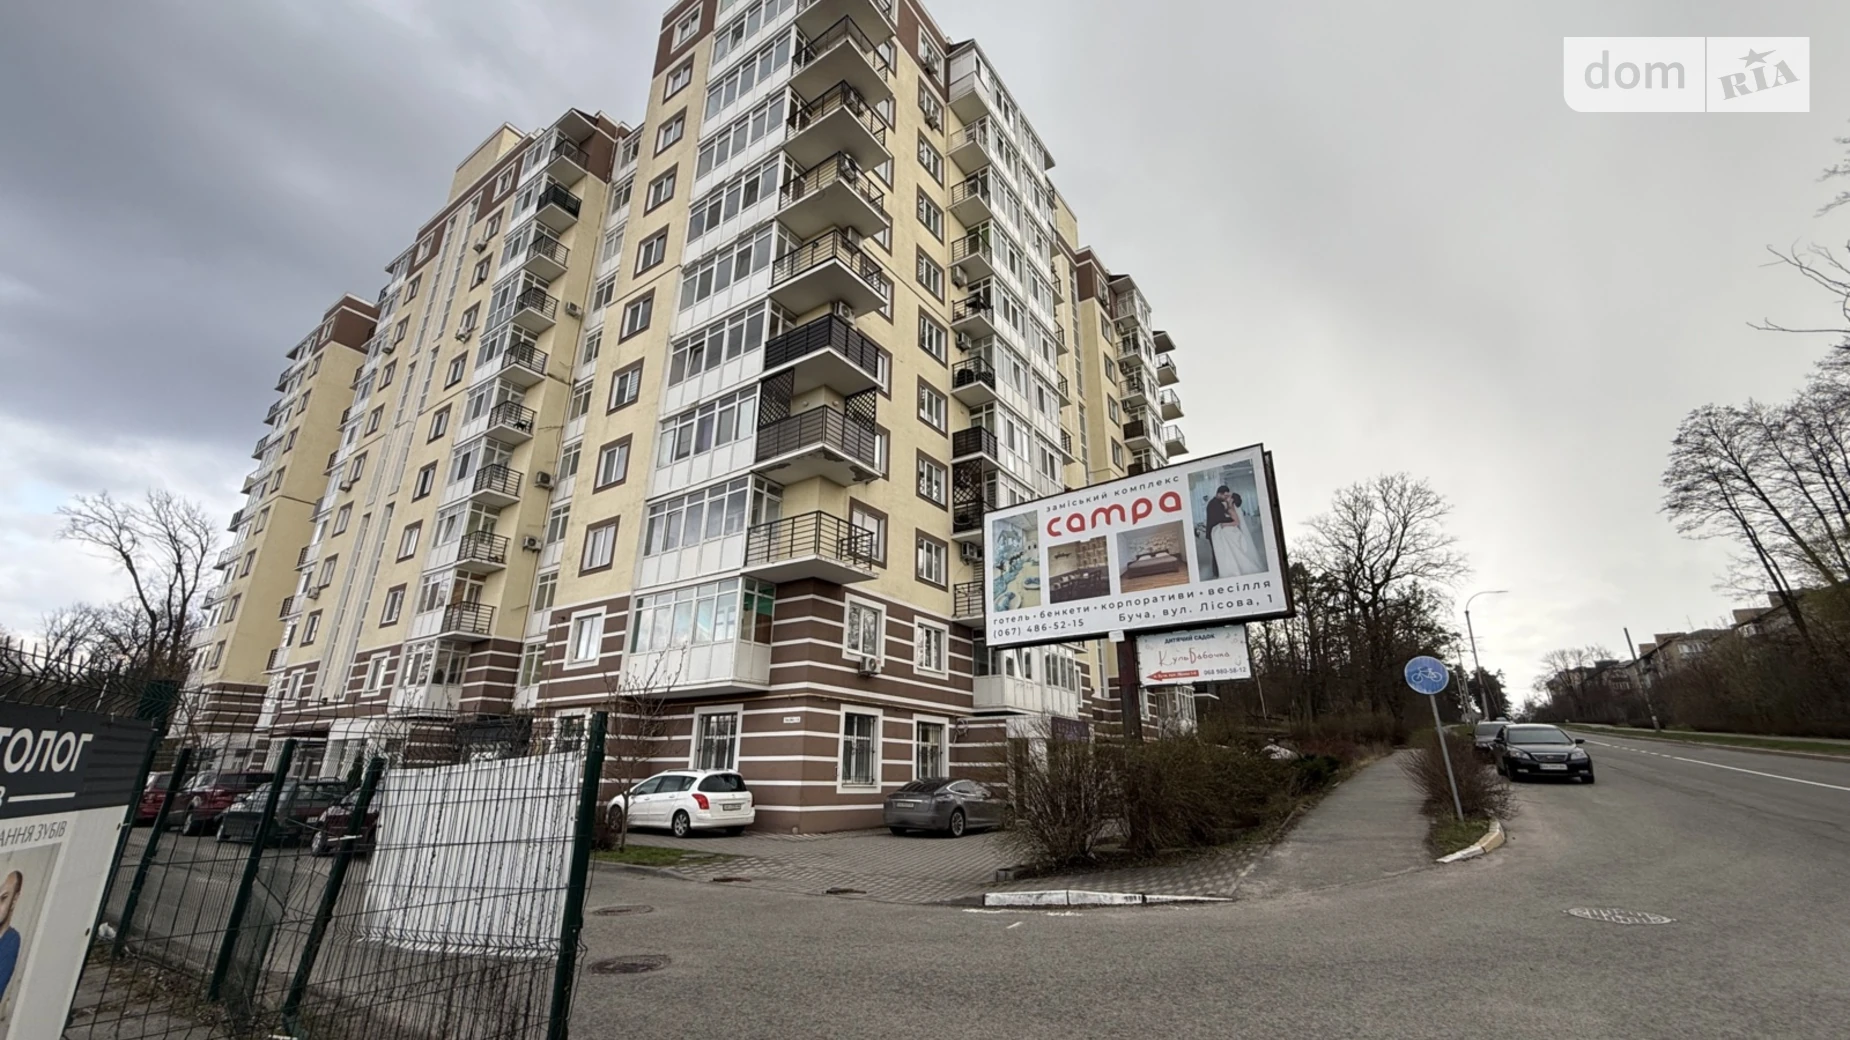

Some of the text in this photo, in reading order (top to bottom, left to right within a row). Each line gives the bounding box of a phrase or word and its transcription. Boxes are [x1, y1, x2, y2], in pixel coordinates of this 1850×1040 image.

[1046, 475, 1179, 513] заміський комплекс
[993, 580, 1271, 625] готель бенкети корпоративи весілля
[1118, 593, 1273, 623] Буча, вул. Лісова, 1
[993, 618, 1084, 639] (067) 486-52-15
[1194, 633, 1215, 641] САДОК
[34, 820, 68, 842] ЗУБІВ
